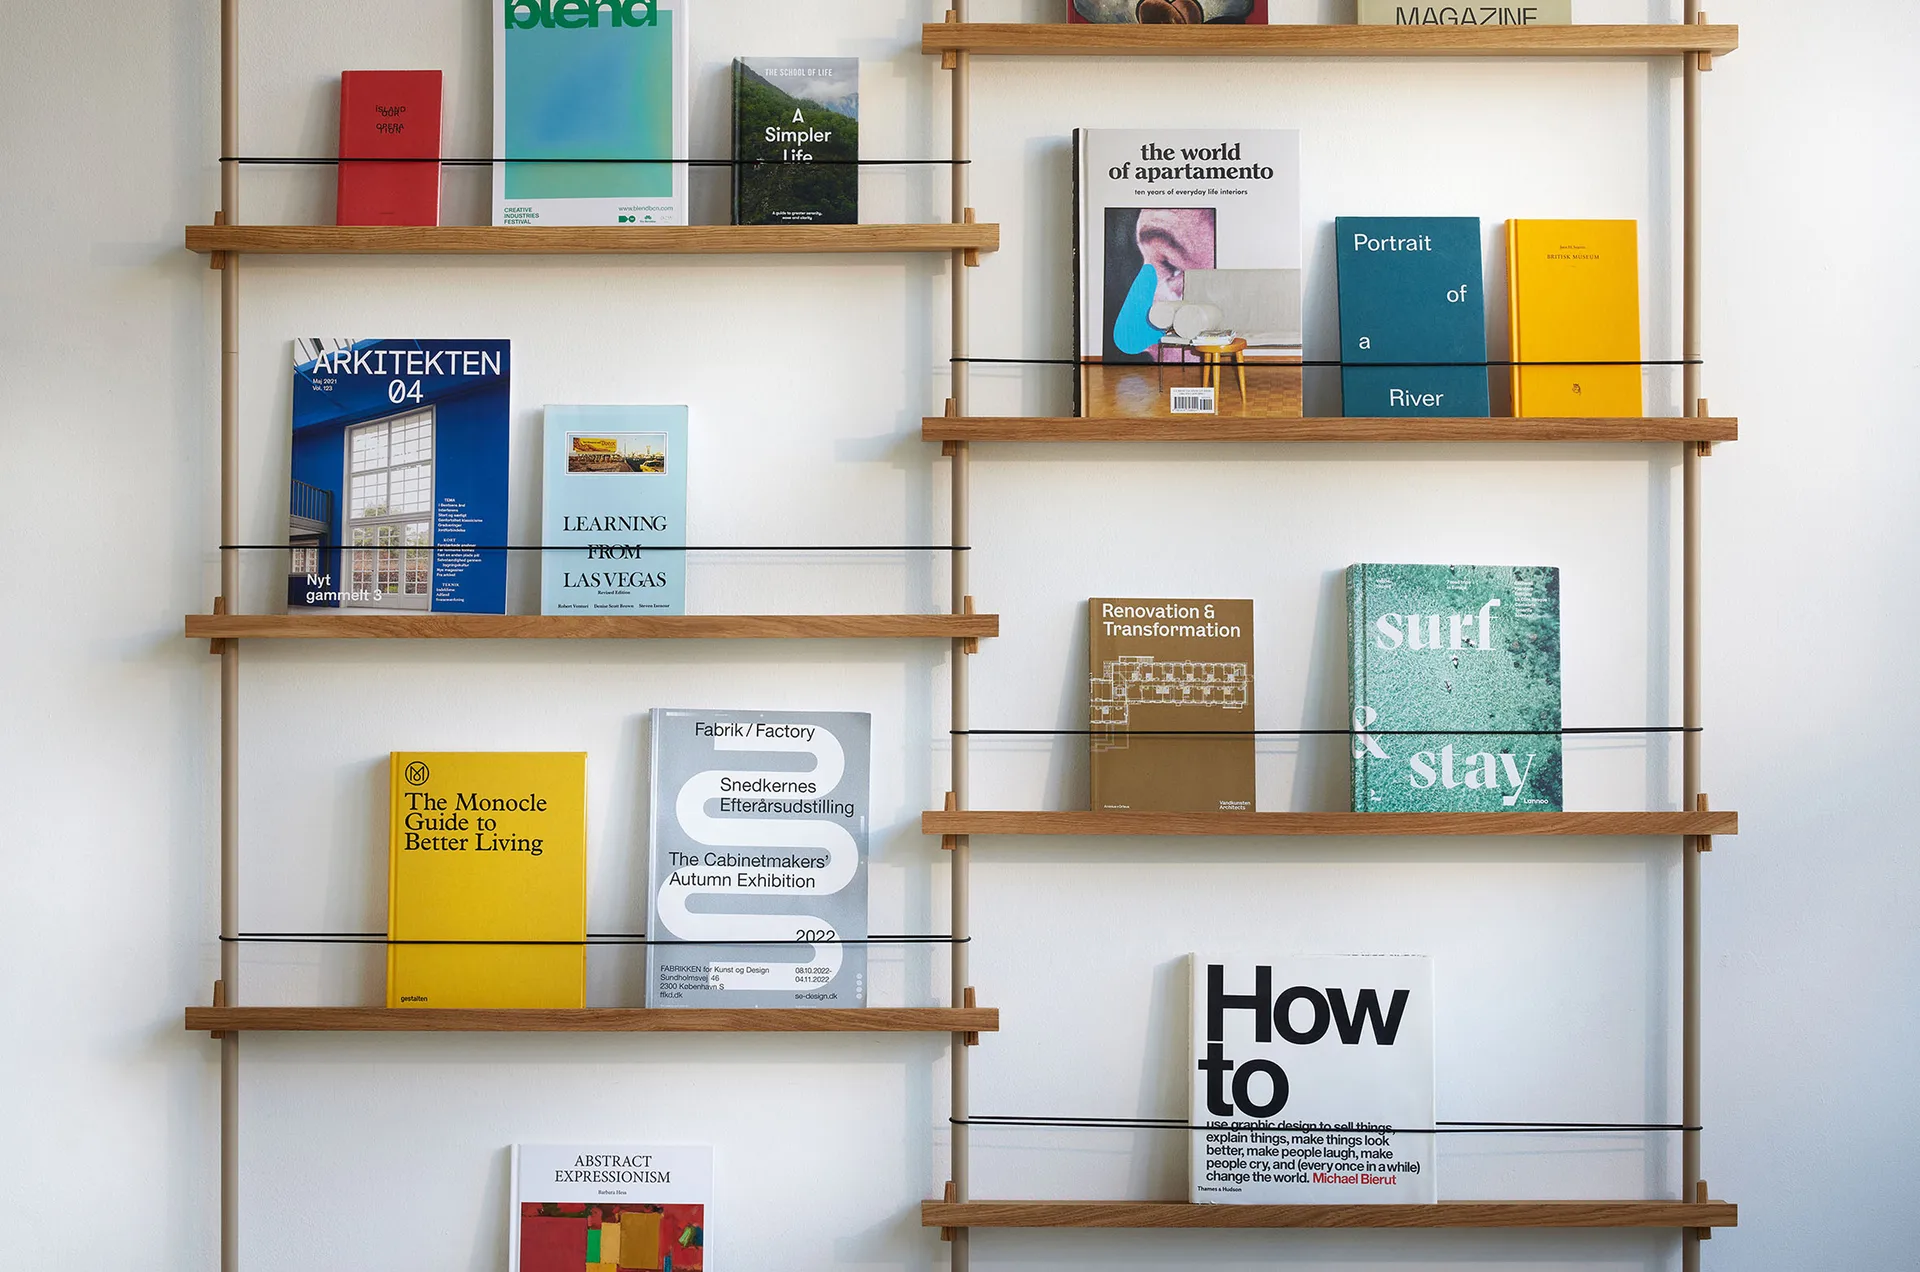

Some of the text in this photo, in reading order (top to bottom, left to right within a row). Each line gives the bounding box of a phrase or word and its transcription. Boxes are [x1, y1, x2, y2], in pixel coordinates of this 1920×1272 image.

[505, 0, 657, 29] blend
[1396, 7, 1537, 25] MAGAZINE
[792, 108, 805, 123] A
[765, 127, 832, 146] Simpler
[784, 149, 813, 165] Life
[1140, 143, 1242, 161] the world
[1108, 162, 1274, 183] of apartamento
[1167, 188, 1174, 196] of
[1175, 189, 1207, 197] everyday
[1220, 188, 1248, 196] interiors
[1354, 233, 1432, 252] Portrait
[1446, 284, 1467, 303] of
[1358, 336, 1371, 350] a
[313, 350, 501, 376] ARKITEKTEN
[313, 378, 323, 386] Maj
[388, 379, 424, 404] 04
[1389, 388, 1444, 407] River
[563, 516, 667, 532] LEARNING
[588, 544, 642, 560] FROM
[306, 574, 331, 589] Nyt
[564, 572, 667, 588] LAS VEGAS
[306, 588, 383, 604] gammelt 3
[1102, 603, 1215, 619] Renovation &
[1103, 621, 1241, 638] Transformation
[1376, 599, 1501, 651] surf
[695, 722, 815, 742] Fabrik / Factory
[1352, 706, 1390, 759] &
[1410, 744, 1537, 806] stay
[720, 778, 817, 794] Snedkernes
[404, 792, 547, 812] The Monocle
[720, 797, 855, 818] Efterårsudstilling
[405, 812, 497, 831] Guide to
[404, 832, 544, 856] Better Living
[669, 852, 829, 869] The Cabinetmakers’
[669, 872, 816, 888] Autumn Exhibition
[796, 929, 836, 943] 2022
[660, 965, 701, 973] FABRIKKEN
[703, 965, 713, 973] for
[714, 966, 734, 974] Kunst
[746, 967, 770, 975] Design
[660, 974, 709, 983] Sundholmsvej
[400, 995, 428, 1003] gestalten
[660, 991, 683, 999] ffkd.dk
[795, 992, 838, 1001] se-design.dk
[1207, 964, 1411, 1045] How
[1198, 1043, 1289, 1119] to
[1206, 1120, 1396, 1135] use graphic design to sell things,
[1206, 1132, 1390, 1147] explain things, make things look
[1206, 1145, 1394, 1161] better, make people laugh, make
[574, 1155, 653, 1168] ABSTRACT
[1206, 1159, 1421, 1174] people cry, and (every once in a while)
[555, 1170, 671, 1184] EXPRESSIONISM
[1206, 1172, 1397, 1185] change the world. Michael Bierut
